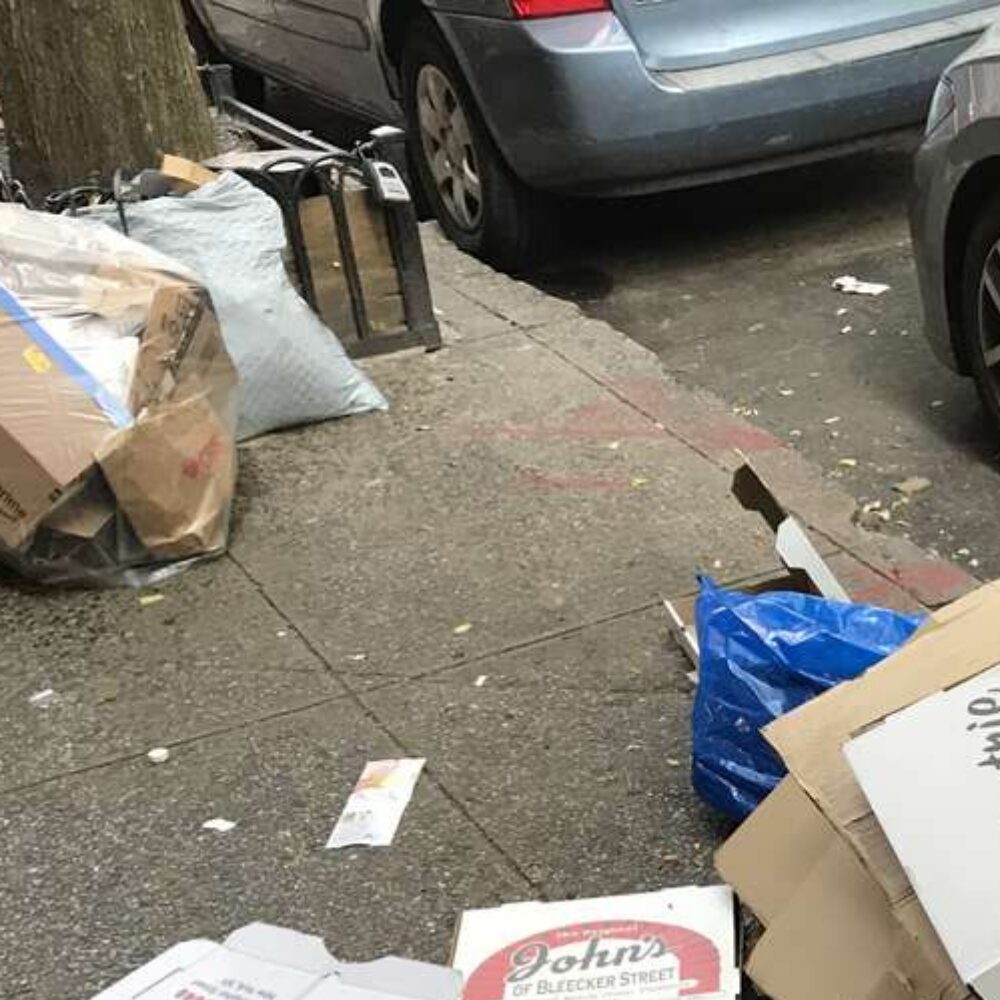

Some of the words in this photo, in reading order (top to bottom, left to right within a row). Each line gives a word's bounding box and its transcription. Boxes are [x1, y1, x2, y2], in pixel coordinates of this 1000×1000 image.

[506, 934, 668, 983] John's
[512, 983, 534, 998] OF
[536, 974, 617, 996] BLEECKER
[620, 966, 676, 988] STREET
